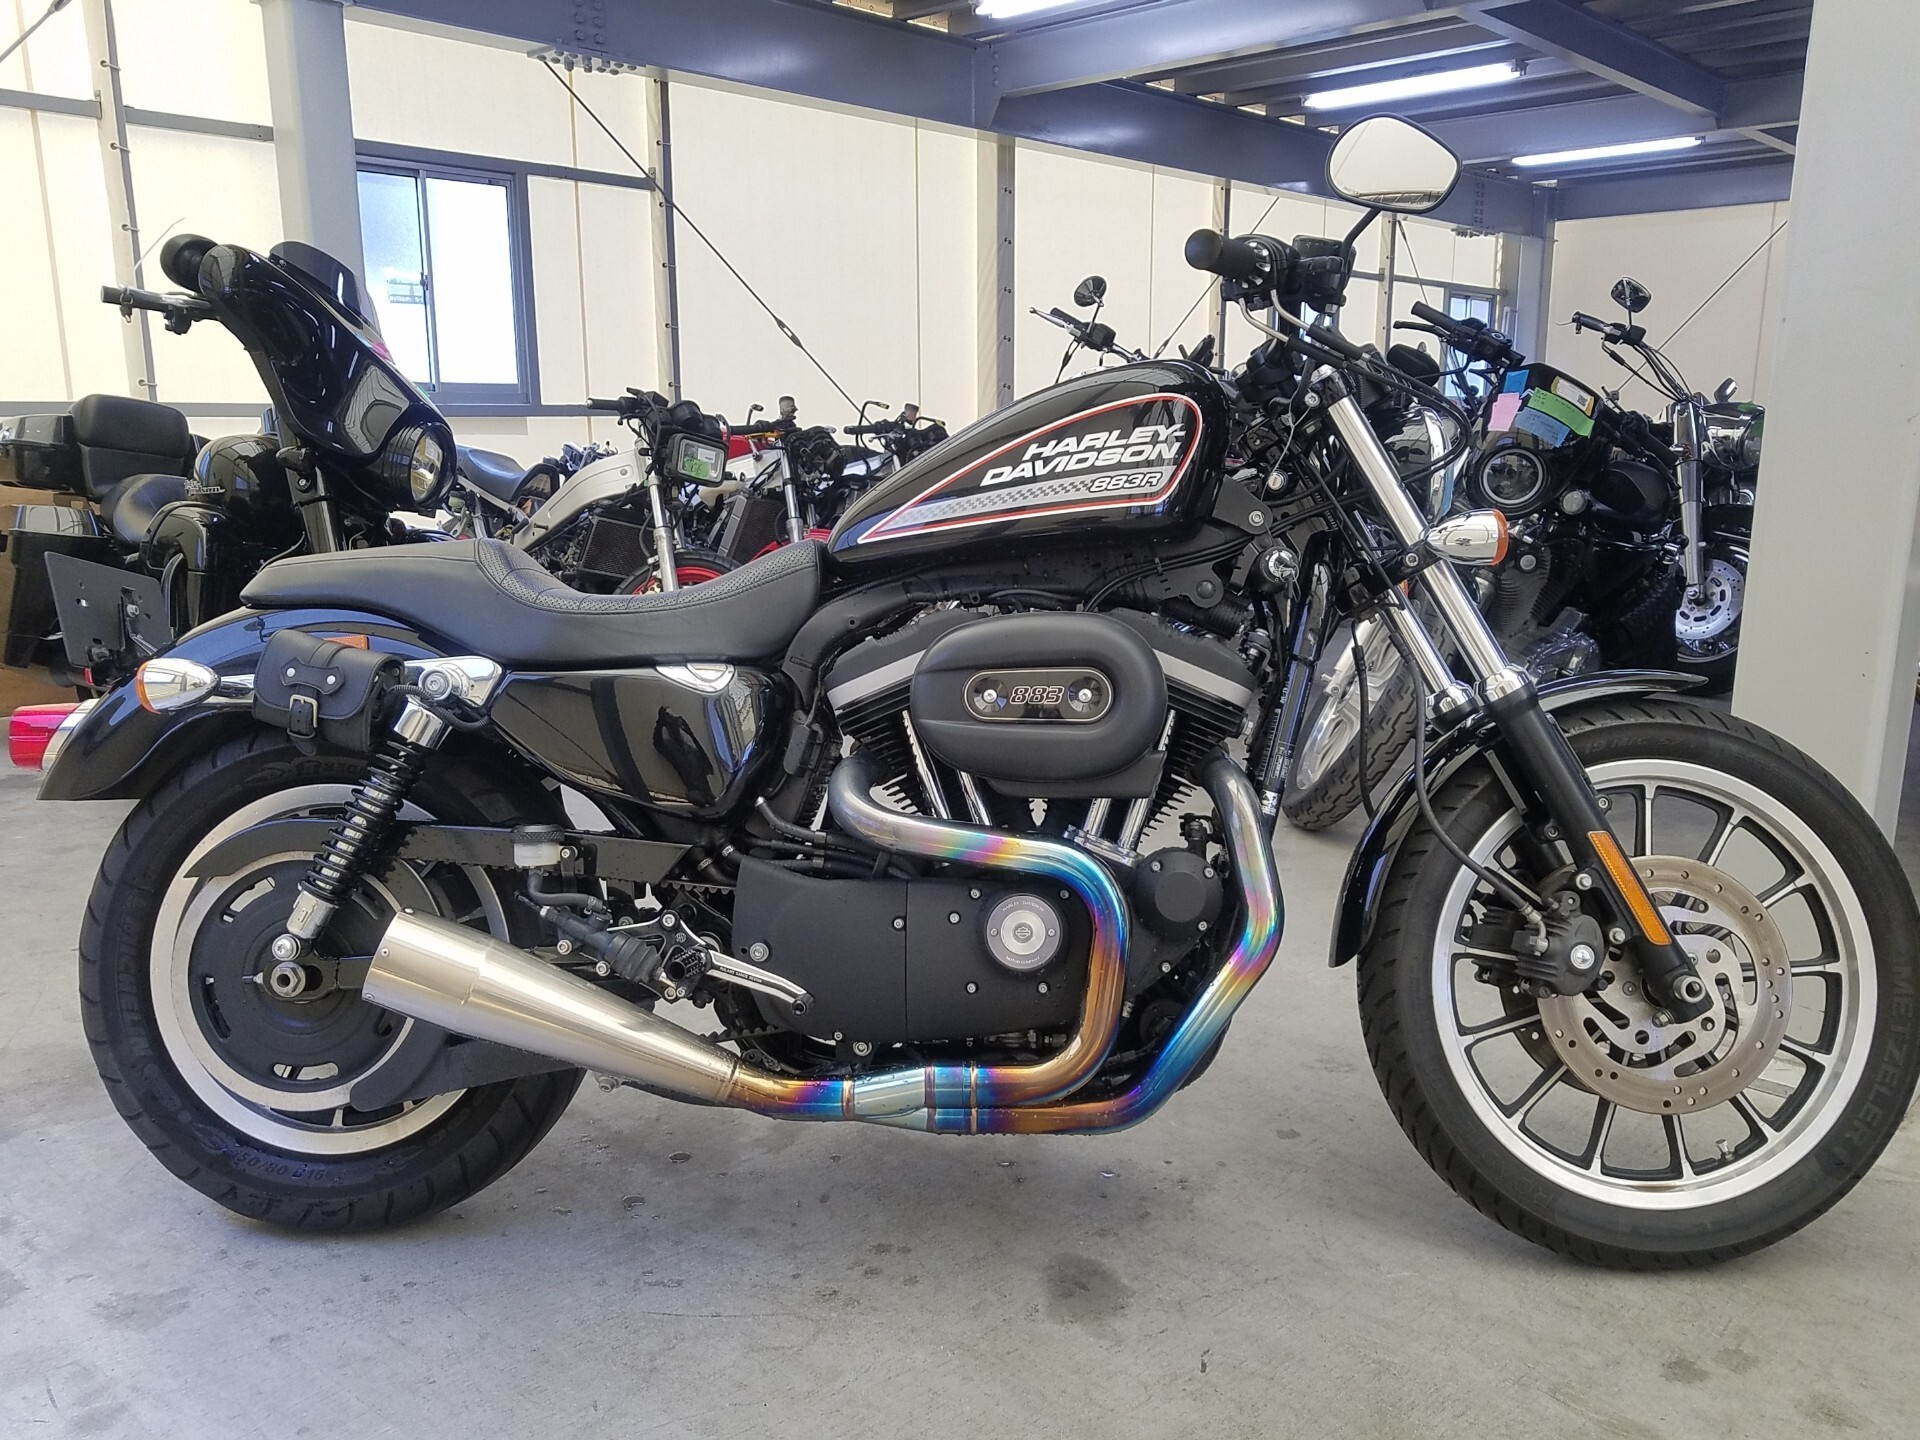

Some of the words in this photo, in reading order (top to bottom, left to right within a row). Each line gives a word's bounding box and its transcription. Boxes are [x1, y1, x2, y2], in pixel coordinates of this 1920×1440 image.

[1022, 423, 1186, 461] HARLEY-
[980, 442, 1182, 487] DAVIDSON
[1089, 471, 1162, 493] 883R
[1010, 686, 1064, 704] 883
[1845, 965, 1914, 1145] METZELER
